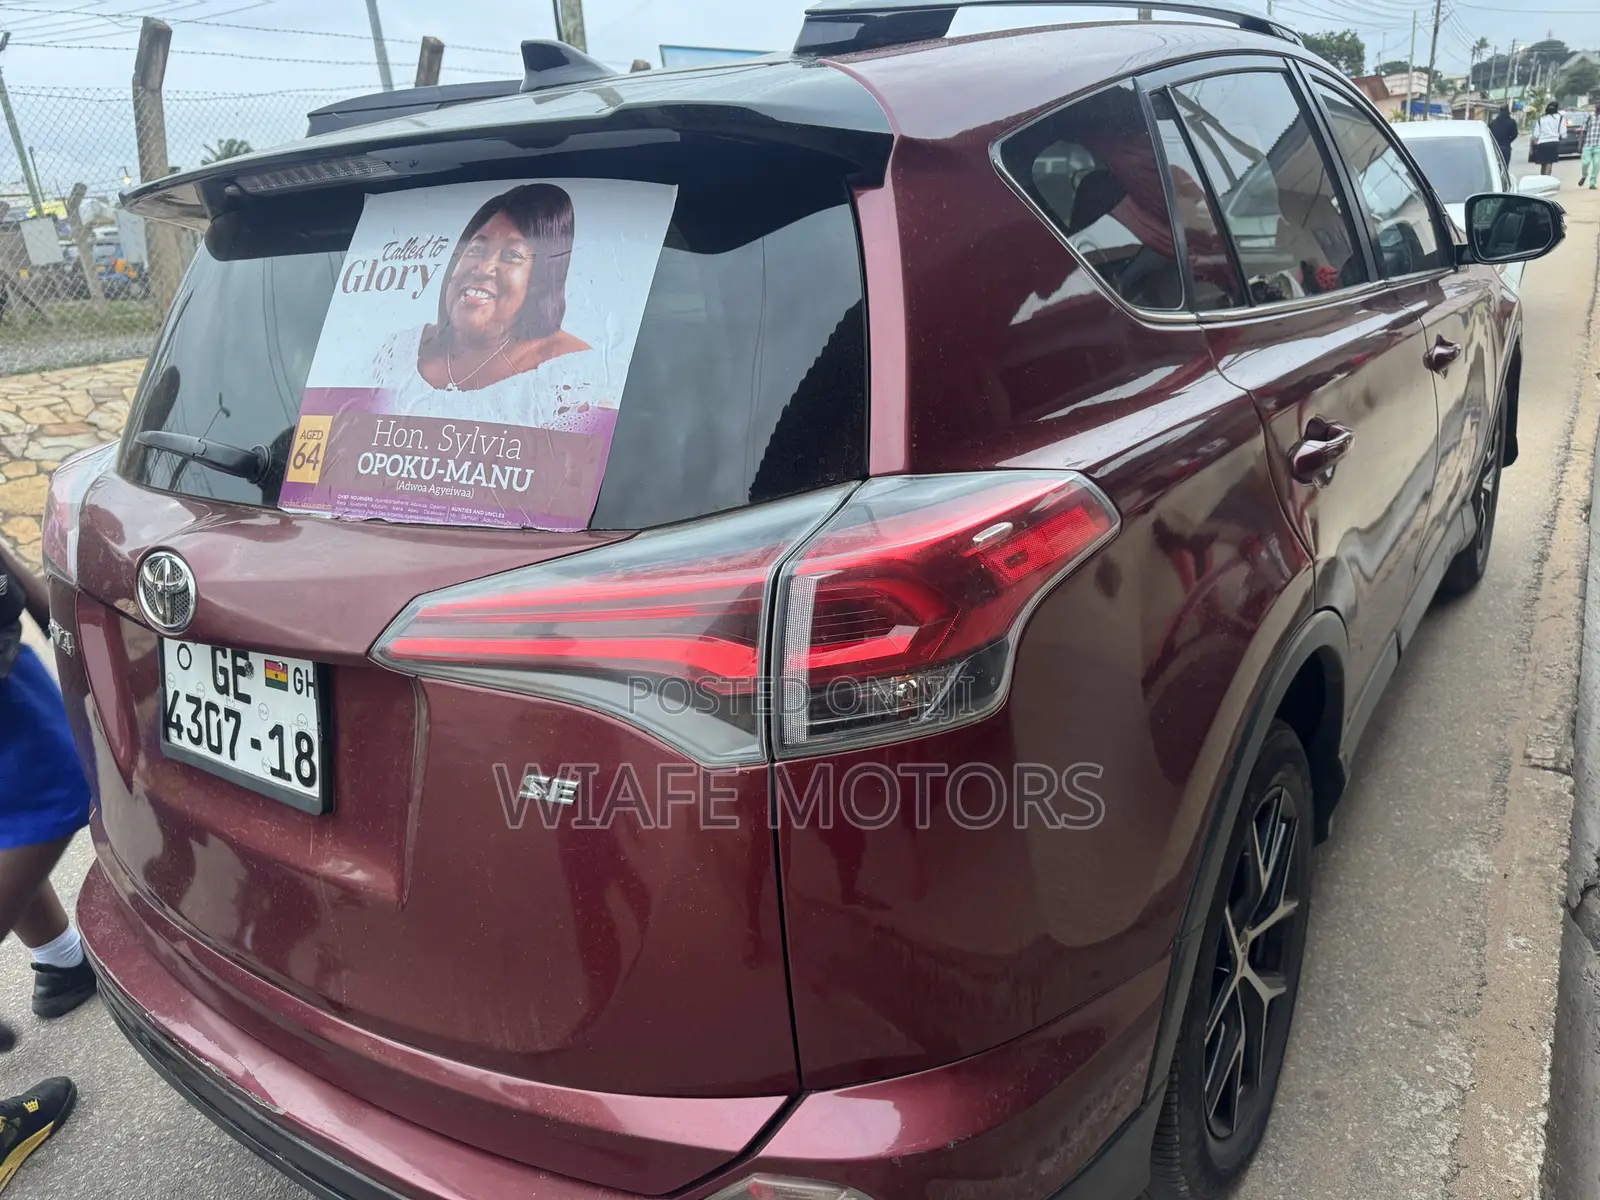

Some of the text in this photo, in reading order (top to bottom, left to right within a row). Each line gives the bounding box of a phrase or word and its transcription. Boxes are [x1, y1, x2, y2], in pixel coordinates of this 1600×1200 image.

[382, 235, 449, 262] Called to
[342, 259, 442, 300] Glory
[300, 430, 323, 440] AGED
[371, 419, 522, 460] Hon. Sylvia
[293, 442, 321, 471] 64
[357, 452, 534, 492] OPOKU-MANU
[396, 479, 475, 499] (Adwoa Agyeiwaa)
[211, 646, 252, 705] GE
[293, 666, 316, 698] GH
[167, 689, 317, 788] 4307-18
